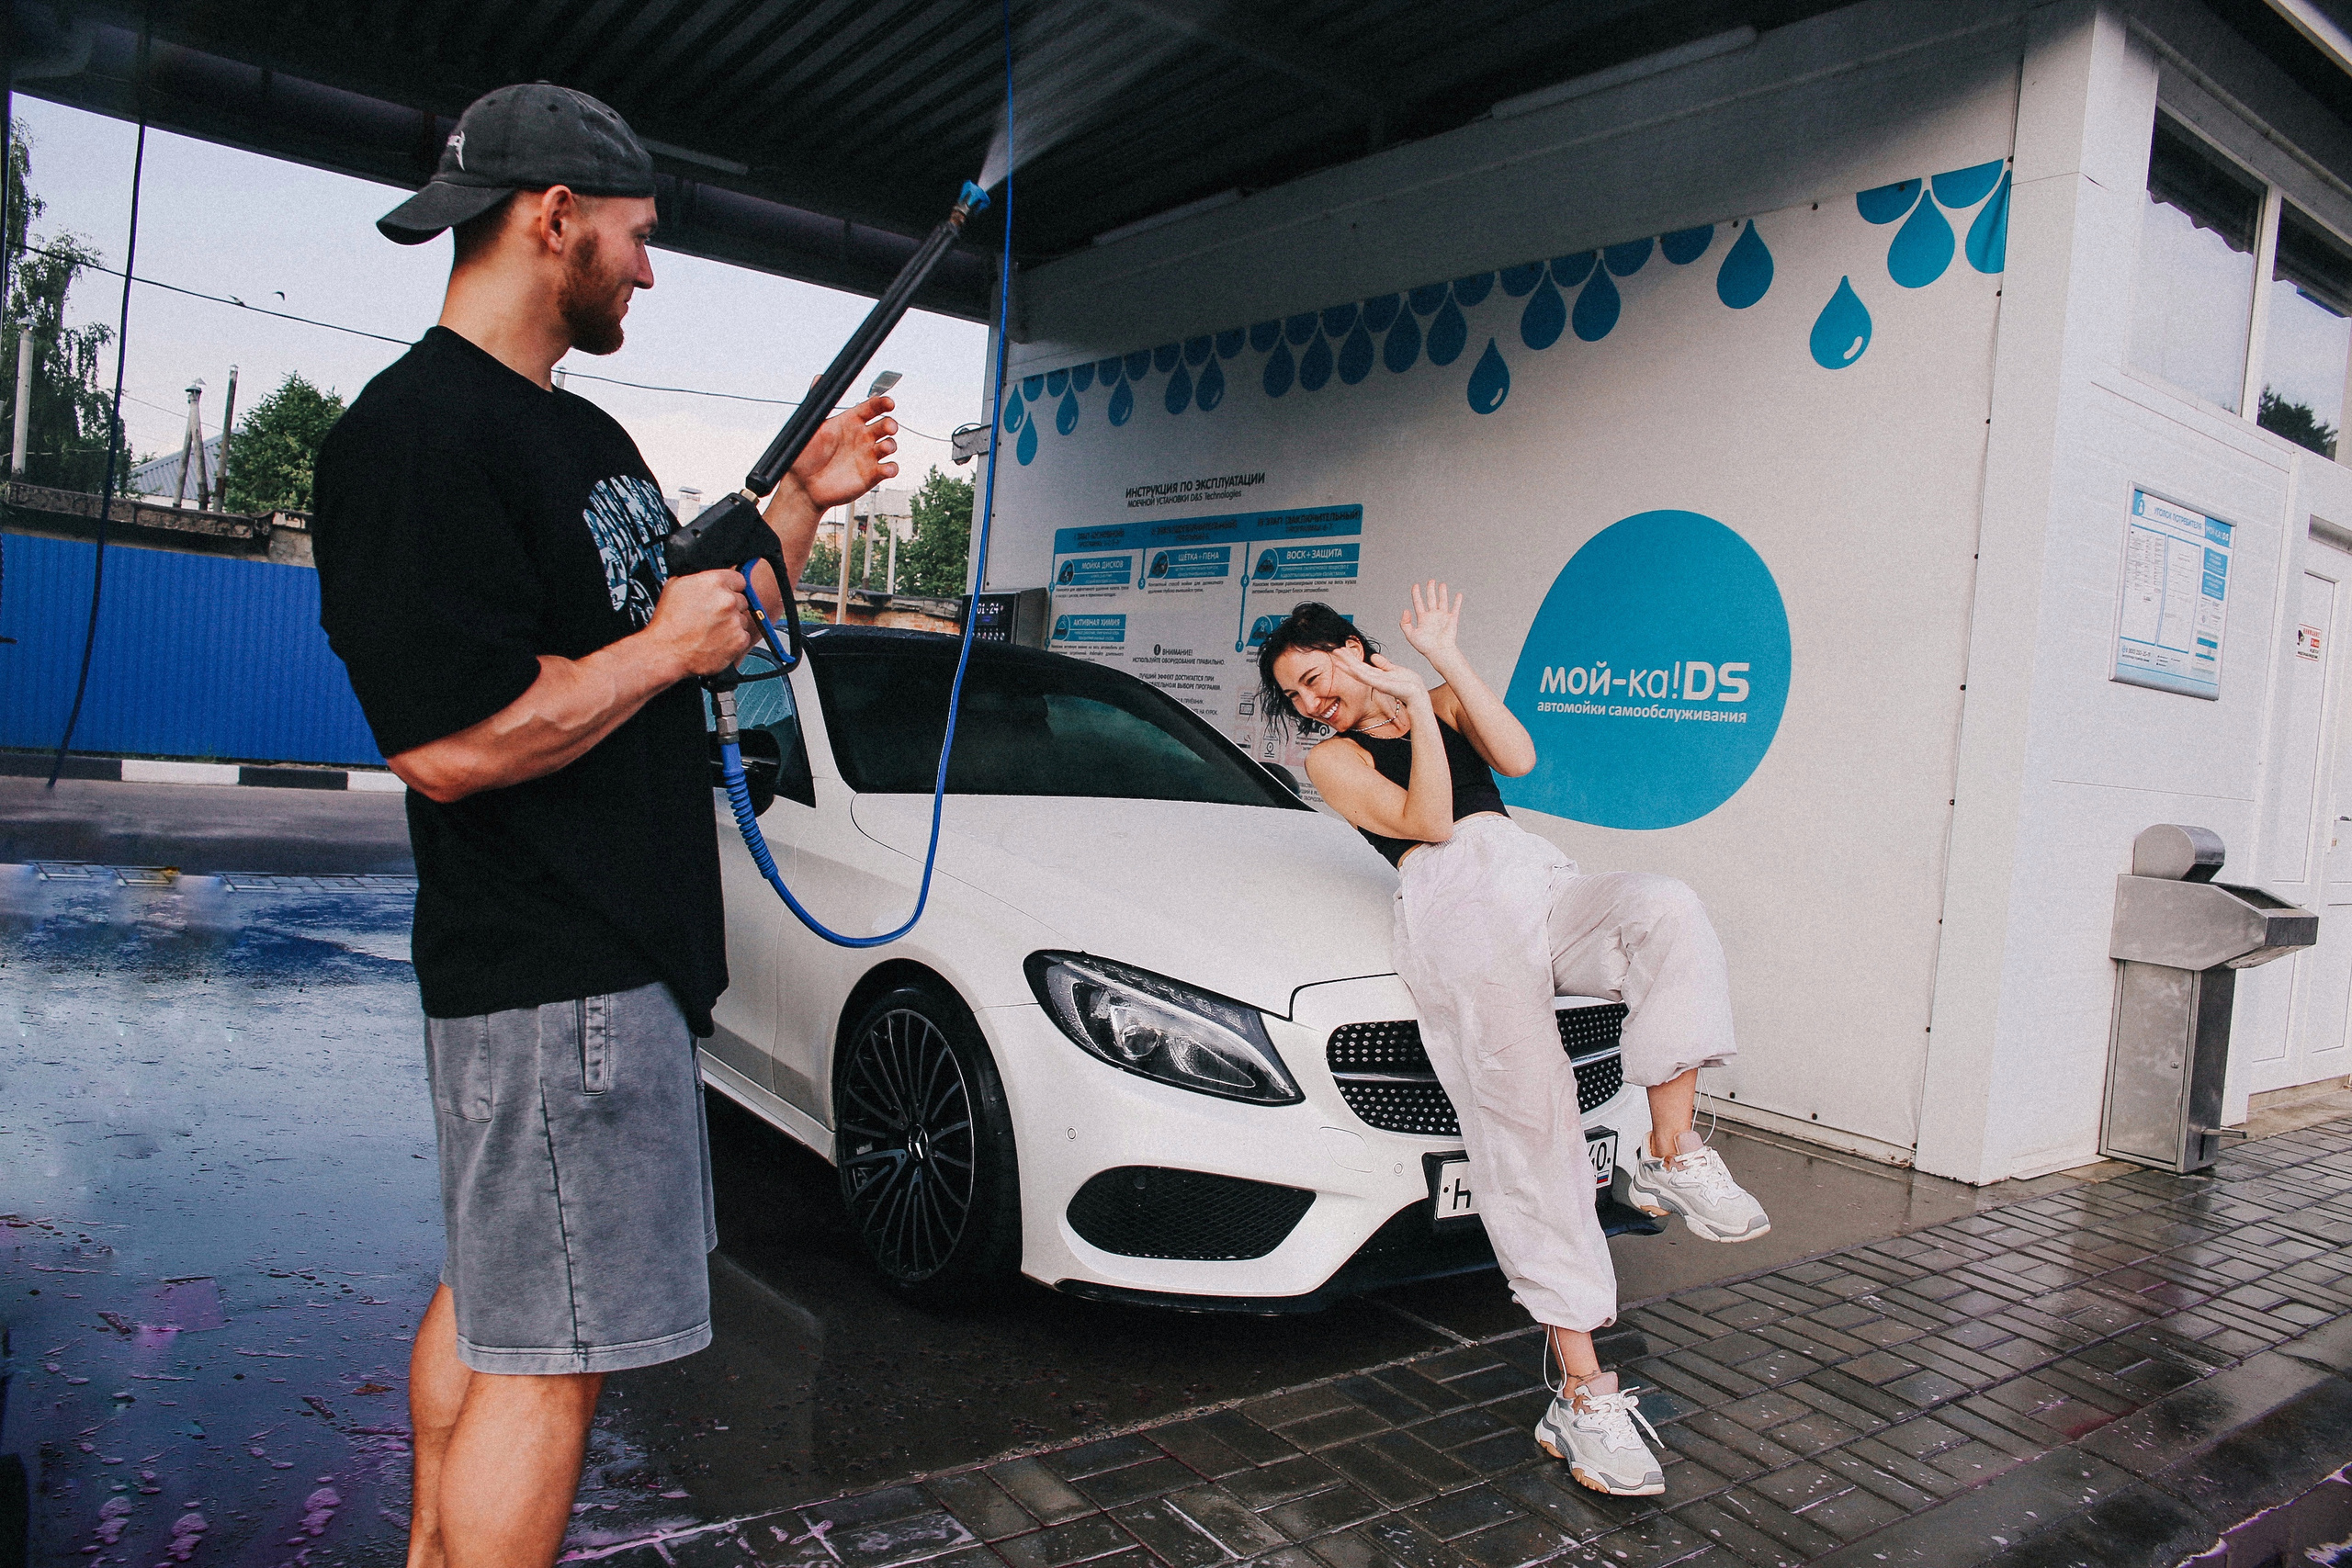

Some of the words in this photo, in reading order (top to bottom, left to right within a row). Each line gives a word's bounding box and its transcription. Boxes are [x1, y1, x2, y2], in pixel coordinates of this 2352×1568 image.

[1125, 483, 1178, 499] ИНСТРУКЦИЯ
[1181, 480, 1193, 492] ПО
[1195, 472, 1266, 491] ЭКСПЛУАТАЦИИ
[1127, 495, 1155, 508] МОЕЧНОЙ
[1156, 493, 1190, 506] УСТАНОВКИ
[1190, 491, 1204, 502] D&S
[1204, 489, 1242, 501] Technologies
[1101, 559, 1124, 570] ДИСКОВ
[1162, 649, 1193, 657] ВНИМАНИЕ!
[1536, 700, 1606, 716] автомойки
[1608, 704, 1747, 724] самообслуживания
